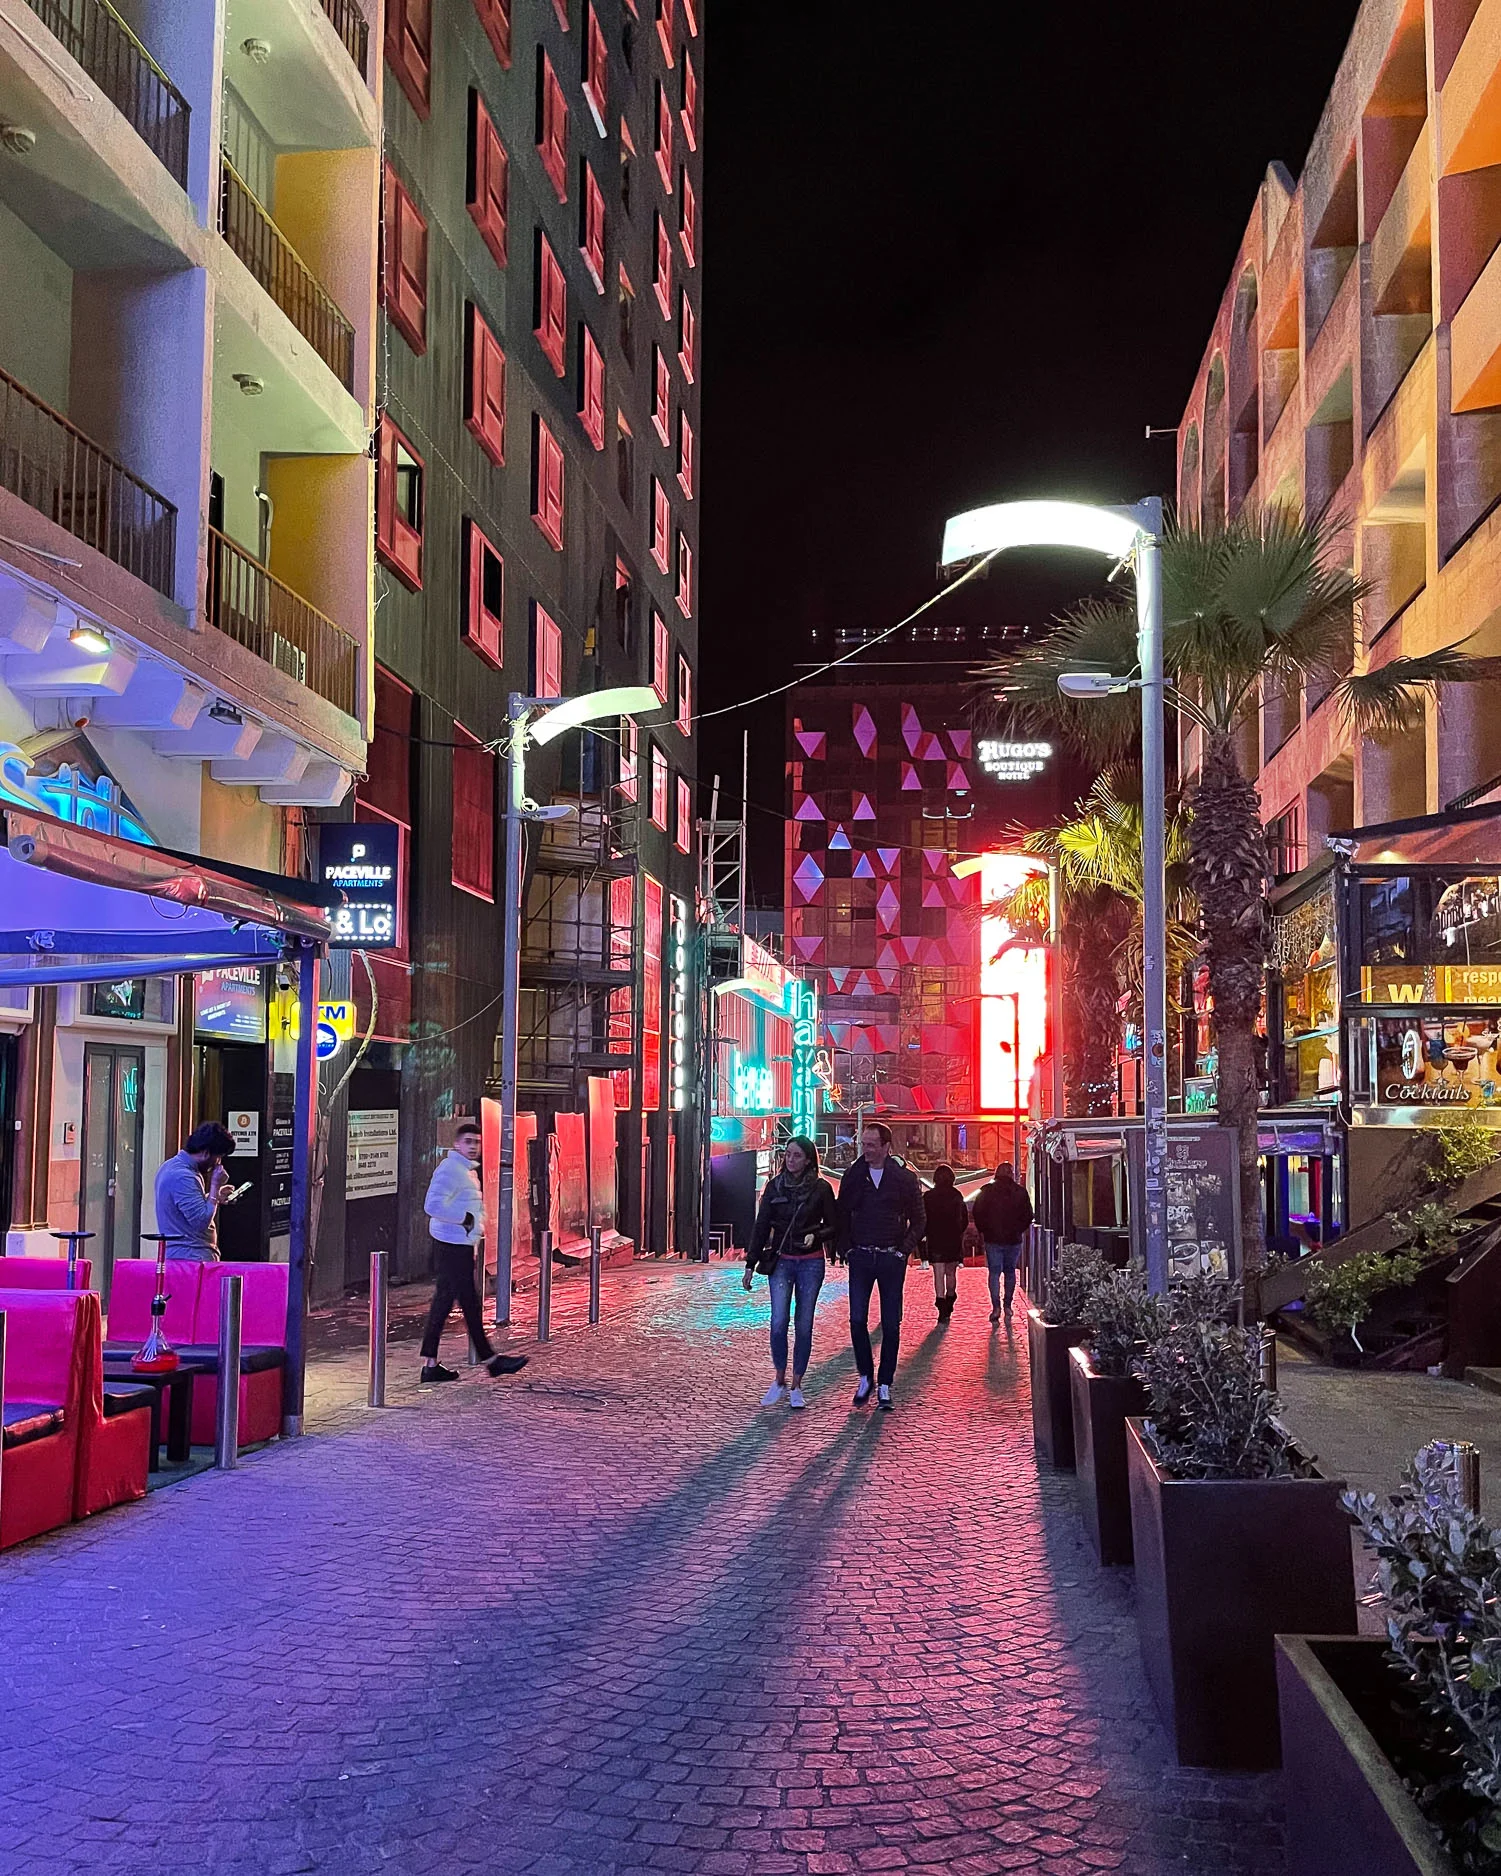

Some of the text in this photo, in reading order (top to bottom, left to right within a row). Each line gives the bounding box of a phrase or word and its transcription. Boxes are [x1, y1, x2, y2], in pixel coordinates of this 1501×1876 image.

[985, 761, 1044, 773] BOUTIQUE
[325, 866, 392, 880] PACEVILLE
[333, 879, 384, 887] APARTMENTS
[336, 910, 354, 934] &
[216, 967, 261, 986] PACEVILLE
[1463, 968, 1501, 987] resp
[221, 981, 256, 996] APARTMENTS
[1385, 1083, 1470, 1100] Cocktails
